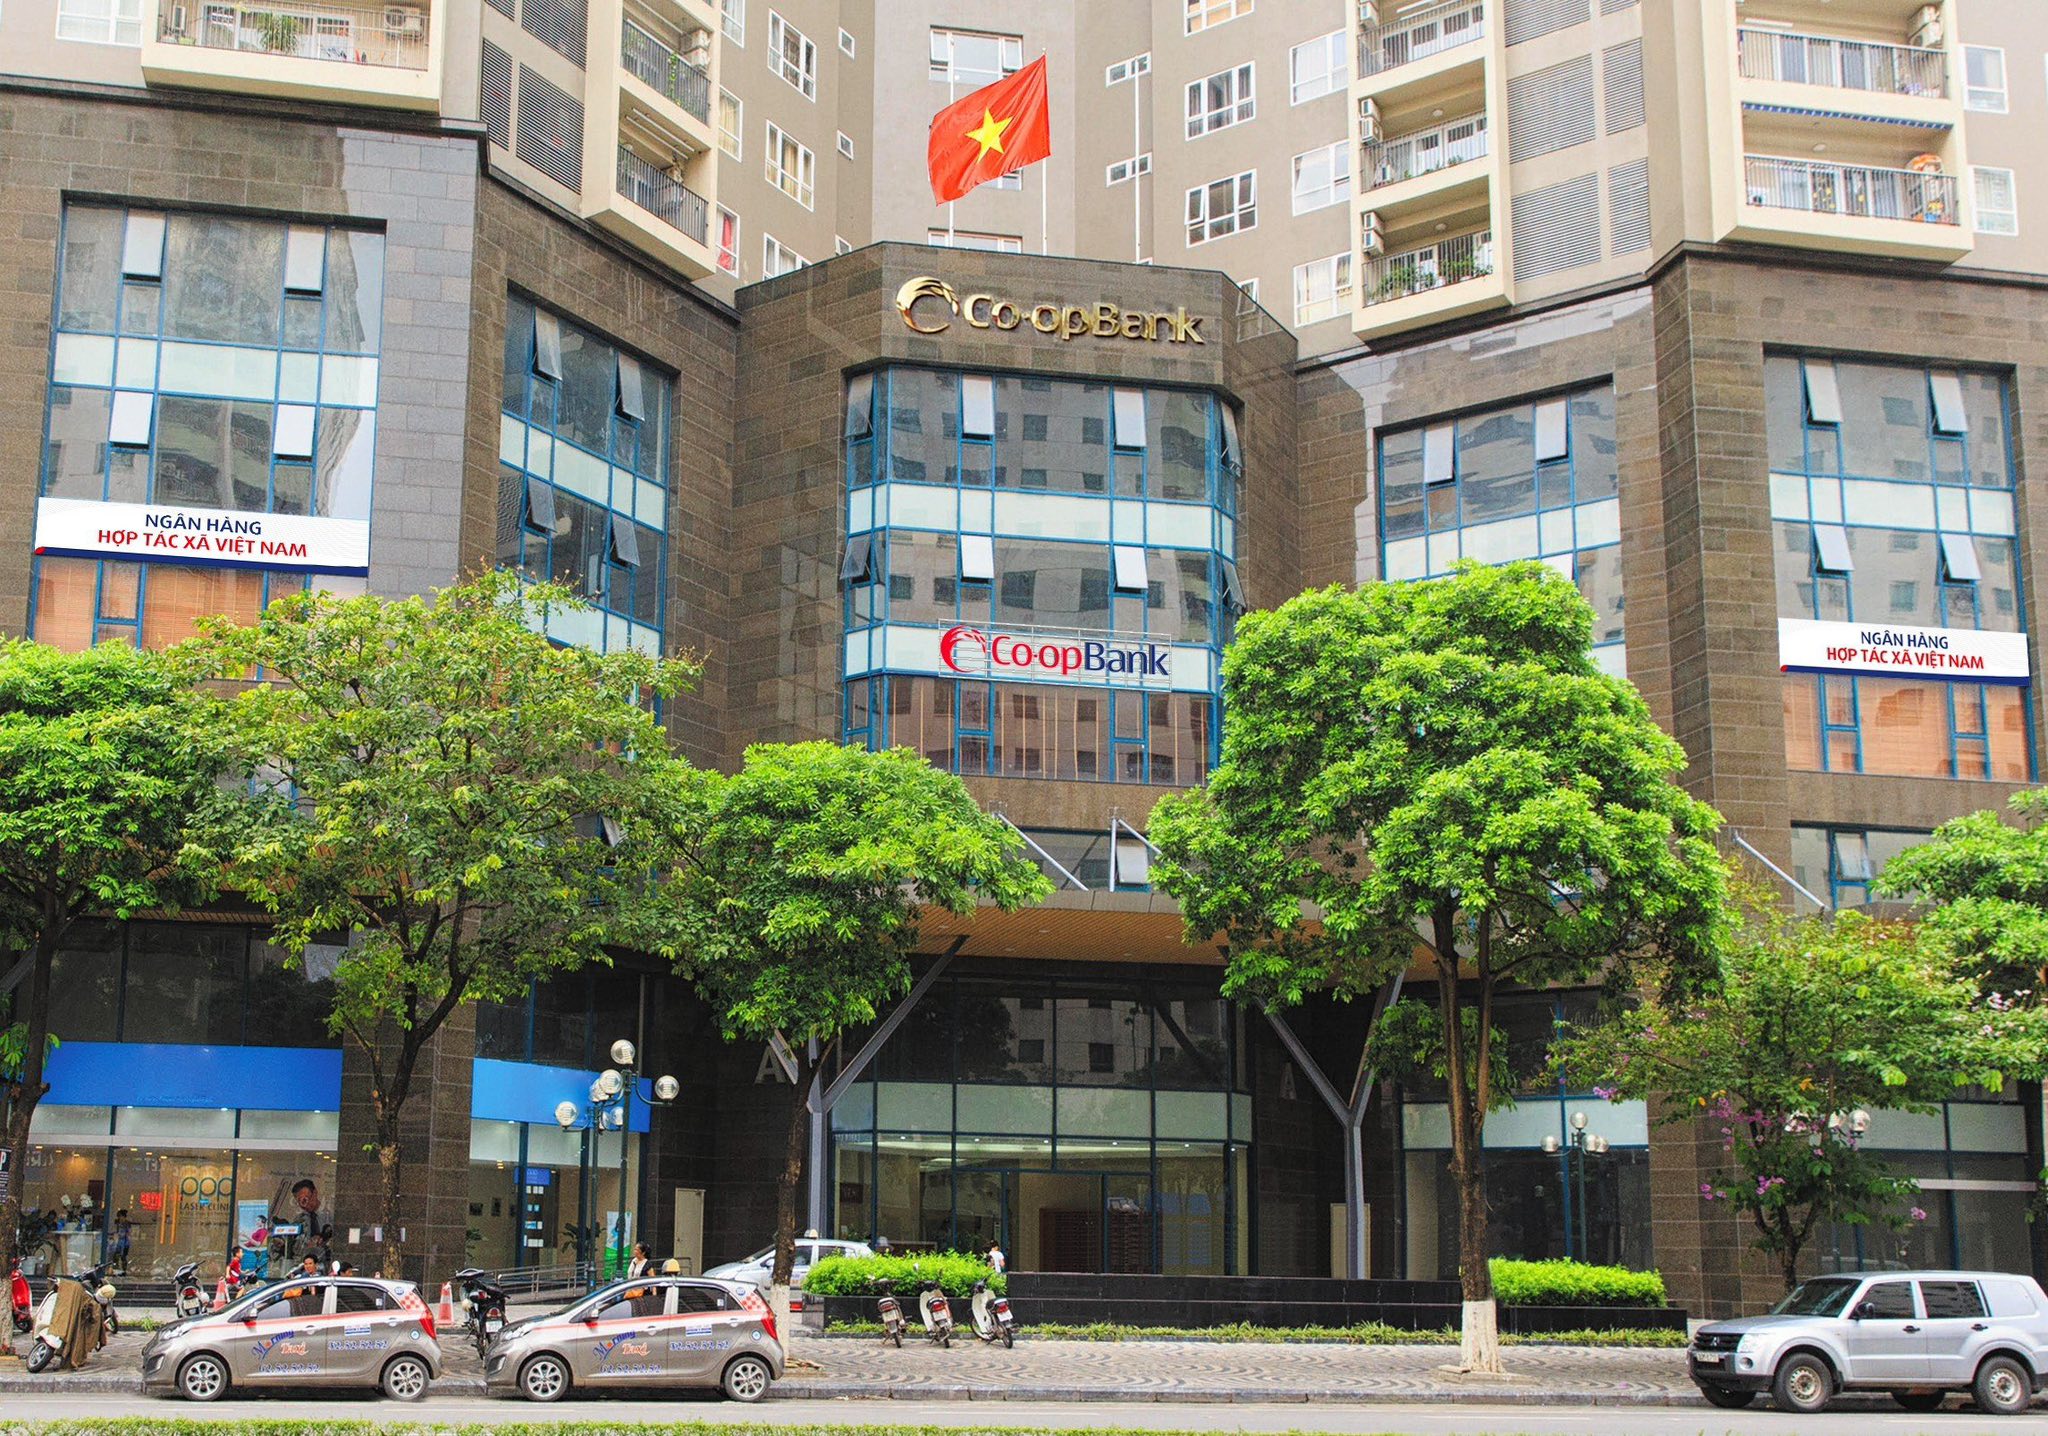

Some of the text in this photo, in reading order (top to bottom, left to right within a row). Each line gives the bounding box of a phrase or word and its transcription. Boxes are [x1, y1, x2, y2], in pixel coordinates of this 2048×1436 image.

[145, 513, 201, 531] NGÂN
[98, 529, 307, 557] HỢP TÁC XÃ VIỆT NAM
[1860, 630, 1949, 650] NGÂN HÀNG
[1827, 647, 1985, 669] HỢP TÁC XÃ VIỆT NAM
[754, 1045, 787, 1084] A
